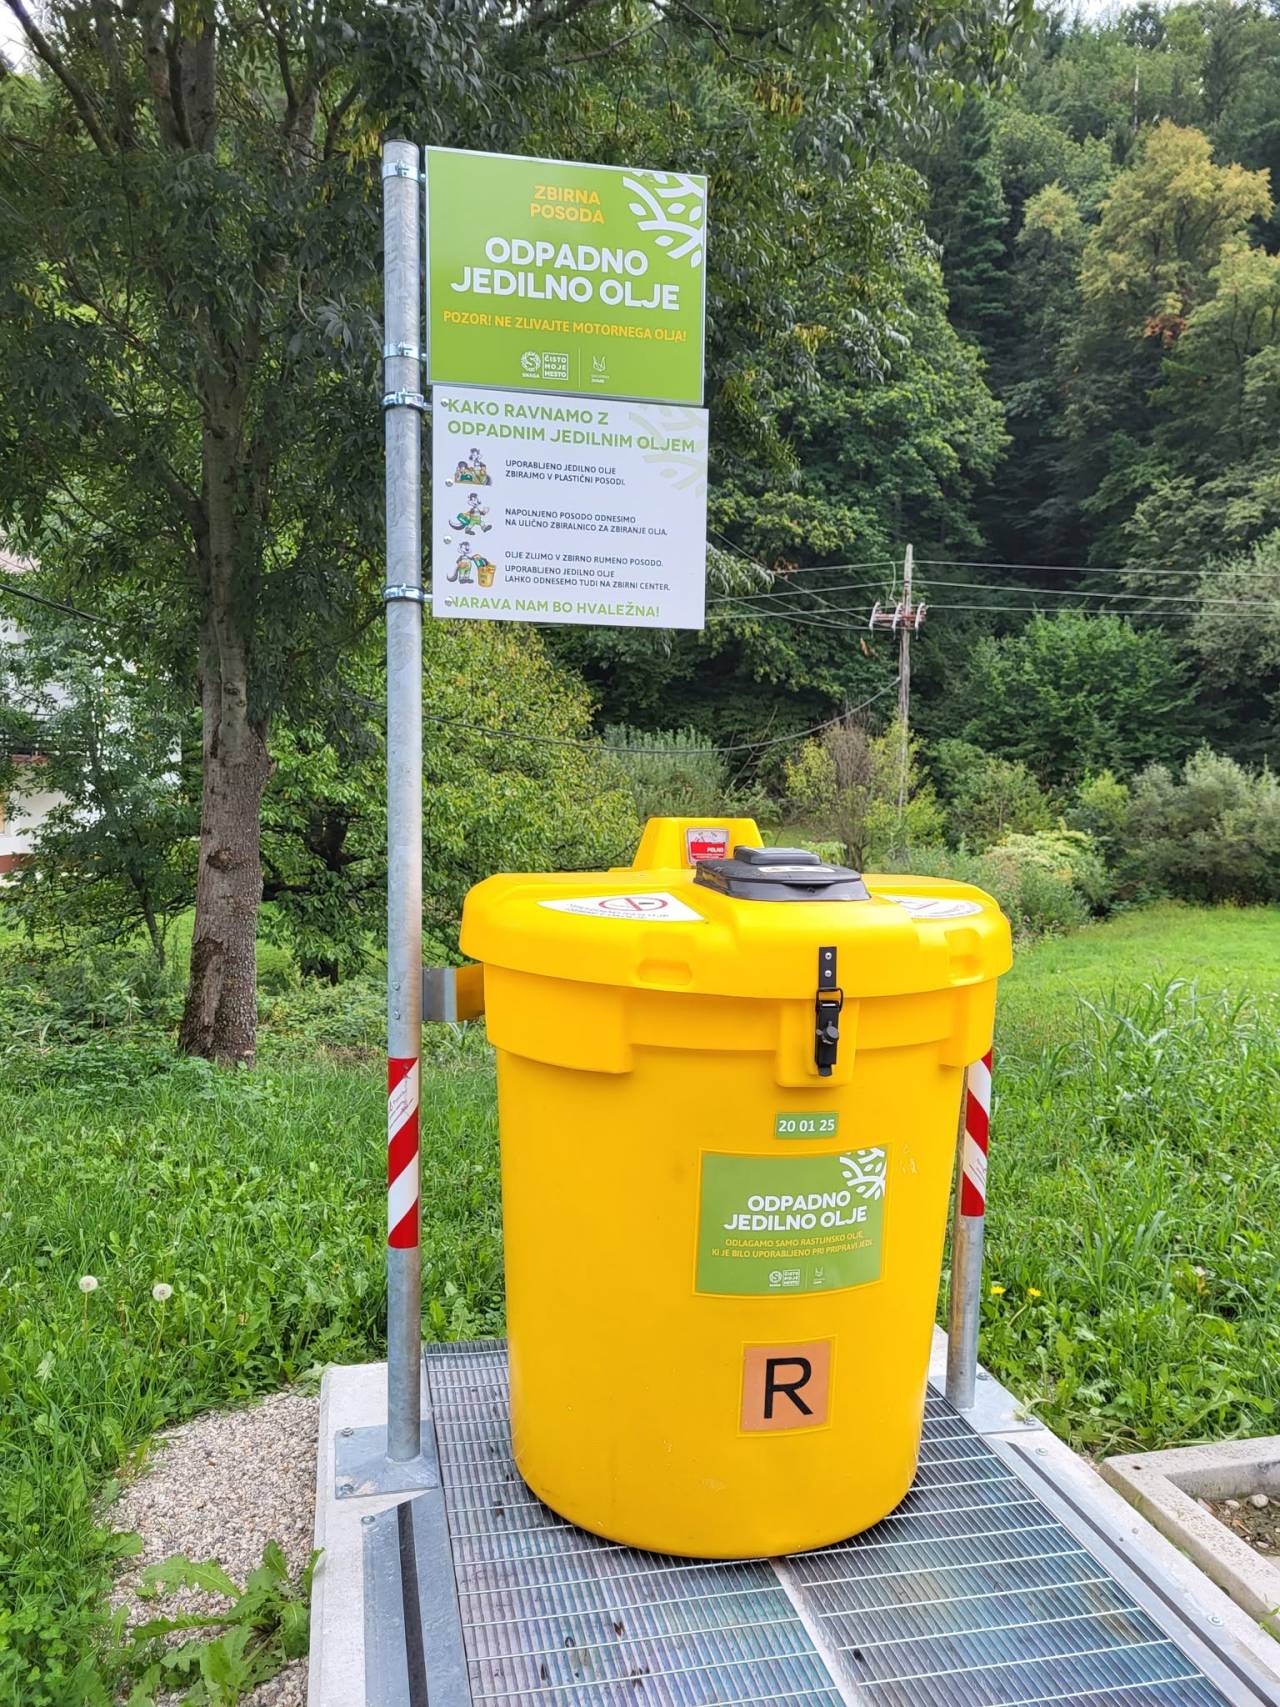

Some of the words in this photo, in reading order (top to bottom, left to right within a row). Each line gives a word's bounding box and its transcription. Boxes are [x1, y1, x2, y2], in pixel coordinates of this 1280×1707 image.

[534, 185, 600, 204] ZBIRNA
[530, 204, 604, 224] POSODA
[486, 237, 648, 276] ODPADNO
[451, 266, 592, 302] JEDILNO
[600, 279, 679, 310] OLJE
[443, 311, 491, 325] POZOR!
[495, 316, 511, 327] NE
[515, 317, 569, 332] ZLIVAJTE
[573, 322, 652, 339] MOTORNEGA
[655, 329, 686, 342] OLJA!
[449, 399, 499, 416] KAKO
[504, 404, 592, 424] RAVNAMO
[598, 412, 608, 425] Z
[448, 420, 545, 441] ODPADNIM
[550, 429, 632, 447] JEDILNIM
[637, 436, 694, 452] OLJEM
[506, 460, 562, 471] UPORABLJENO
[563, 464, 596, 473] JEDILNO
[506, 470, 545, 480] ZBIRAJMO
[555, 474, 593, 484] PLASTIČNI
[595, 476, 625, 486] POSODI.
[505, 508, 558, 519] NAPOLNJENO
[560, 512, 592, 521] POSODO
[595, 514, 636, 524] ODNESIMO
[505, 519, 517, 527] NA
[519, 519, 548, 529] ULIČNO
[550, 522, 596, 532] ZBIRALNICO
[610, 525, 646, 534] ZBIRANJE
[505, 551, 523, 560] OLJE
[525, 552, 553, 561] ZLIJMO
[562, 555, 592, 563] ZBIRNO
[594, 556, 628, 565] RUMENO
[630, 559, 663, 567] POSODO.
[505, 566, 561, 576] UPORABLJENO
[563, 568, 594, 577] JEDILNO
[596, 570, 614, 578] OLJE
[505, 576, 531, 584] LAHKO
[533, 578, 577, 587] ODNESEMO
[613, 581, 638, 589] ZBIRNI
[448, 596, 511, 610] NARAVA
[516, 599, 548, 612] NAM
[553, 602, 572, 612] BO
[577, 603, 659, 617] HVALEŽNA!
[778, 1120, 795, 1132] 20
[800, 1120, 815, 1132] 01
[819, 1119, 835, 1131] 25
[748, 1191, 850, 1211] ODPADNO
[724, 1212, 816, 1230] JEDILNO
[820, 1206, 867, 1228] OLJE
[725, 1239, 773, 1248] ODLAGAMO
[776, 1239, 799, 1247] SAMO
[800, 1234, 845, 1245] RASTLINSKO
[712, 1248, 720, 1256] KI
[732, 1249, 749, 1258] BILO
[752, 1248, 810, 1258] UPORABLJENO
[812, 1247, 824, 1255] PRI
[764, 1357, 814, 1419] R
